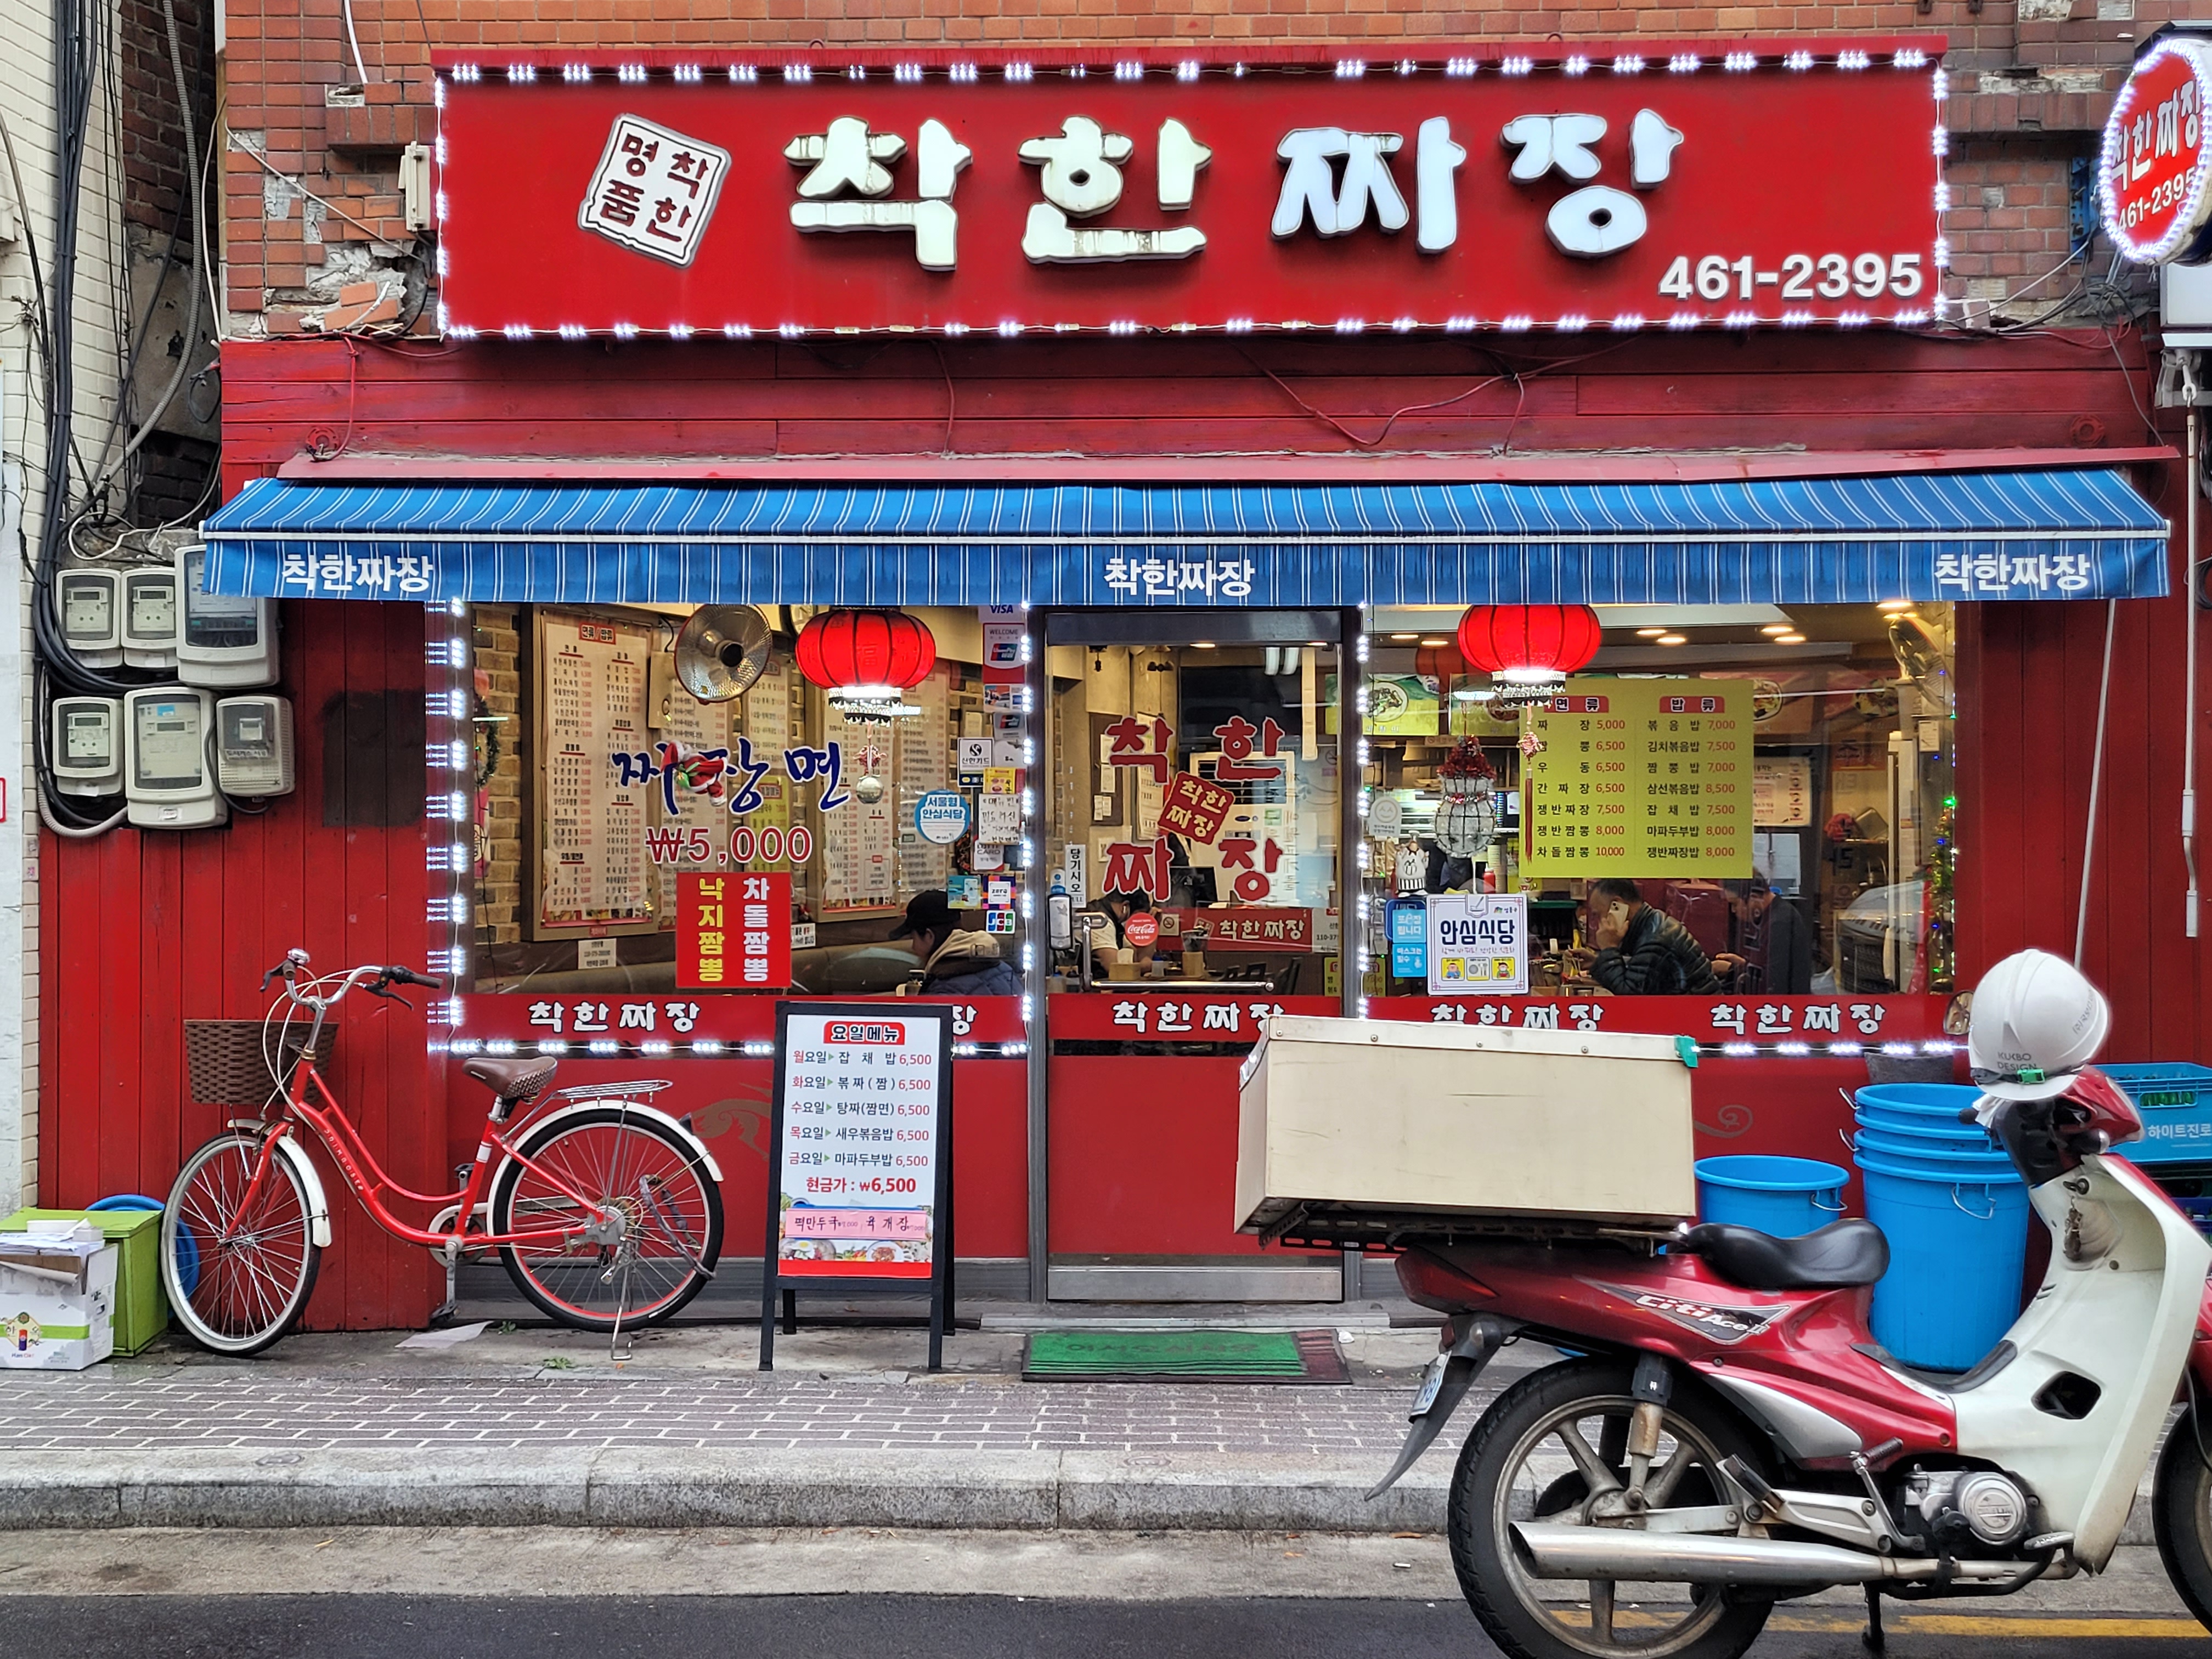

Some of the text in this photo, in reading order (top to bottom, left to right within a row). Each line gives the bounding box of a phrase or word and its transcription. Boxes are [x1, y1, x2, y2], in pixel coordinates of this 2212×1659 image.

[1658, 252, 1924, 300] 461-2395
[281, 554, 434, 592] 착한짜장
[1104, 558, 1255, 596] 착한짜장
[1934, 554, 2090, 591] 착한짜장
[990, 605, 1013, 613] VISA
[1555, 698, 1600, 712] 면류
[1671, 698, 1716, 712] 밥류
[1596, 720, 1625, 730] 5,000
[1647, 719, 1735, 731] 볶음밥 7,000
[1106, 716, 1284, 784] 착한
[1596, 741, 1625, 752] 6,500
[1647, 741, 1735, 752] 김치볶음밥 7,500
[1596, 763, 1625, 772] 6,500
[1647, 761, 1735, 774] 짬뽕밥 7,000
[1596, 783, 1625, 794] 6,500
[1647, 783, 1735, 794] 삼선볶음밥 8,500
[1180, 780, 1227, 814] 착한
[923, 809, 963, 819] 안심식당
[1596, 805, 1625, 815] 7,500
[1647, 804, 1735, 816] 잡채밥 7,500
[1166, 805, 1215, 837] 짜장
[1596, 826, 1625, 837] 8,000
[1647, 826, 1735, 837] 마파두부밥 8,000
[646, 827, 811, 864] ₩5,000
[1596, 847, 1625, 857] 10,000
[1647, 847, 1735, 858] 쟁반짜장밥 8,000
[1070, 848, 1081, 893] 당기시오
[1103, 837, 1283, 901] 짜장
[698, 878, 725, 981] 낙지짬뽕
[743, 878, 769, 981] 차돌짬뽕
[1220, 919, 1305, 940] 착한짜장
[1440, 919, 1515, 945] 안심식당
[529, 1001, 700, 1032] 착한짜장
[1711, 1003, 1885, 1035] 착한짜장
[831, 1025, 899, 1042] 요일메뉴
[793, 1050, 827, 1064] 월요일
[899, 1054, 932, 1066] 6,500
[1997, 1052, 2032, 1061] KUKBO
[1997, 1062, 2037, 1071] DESIGN
[792, 1076, 826, 1089] 화요일
[899, 1080, 931, 1091] 6,500
[791, 1101, 930, 1117] 수요일 탕짜(짬면) 6,500
[790, 1126, 929, 1142] 목요일 새우볶음밥 6,500
[2147, 1123, 2212, 1139] 하이트진로
[789, 1152, 928, 1167] 금요일 마파두부밥 6,500
[806, 1177, 847, 1194] 현금가
[866, 1215, 908, 1232] 육개장
[1635, 1294, 1712, 1317] Citi
[1699, 1313, 1748, 1331] Ace
